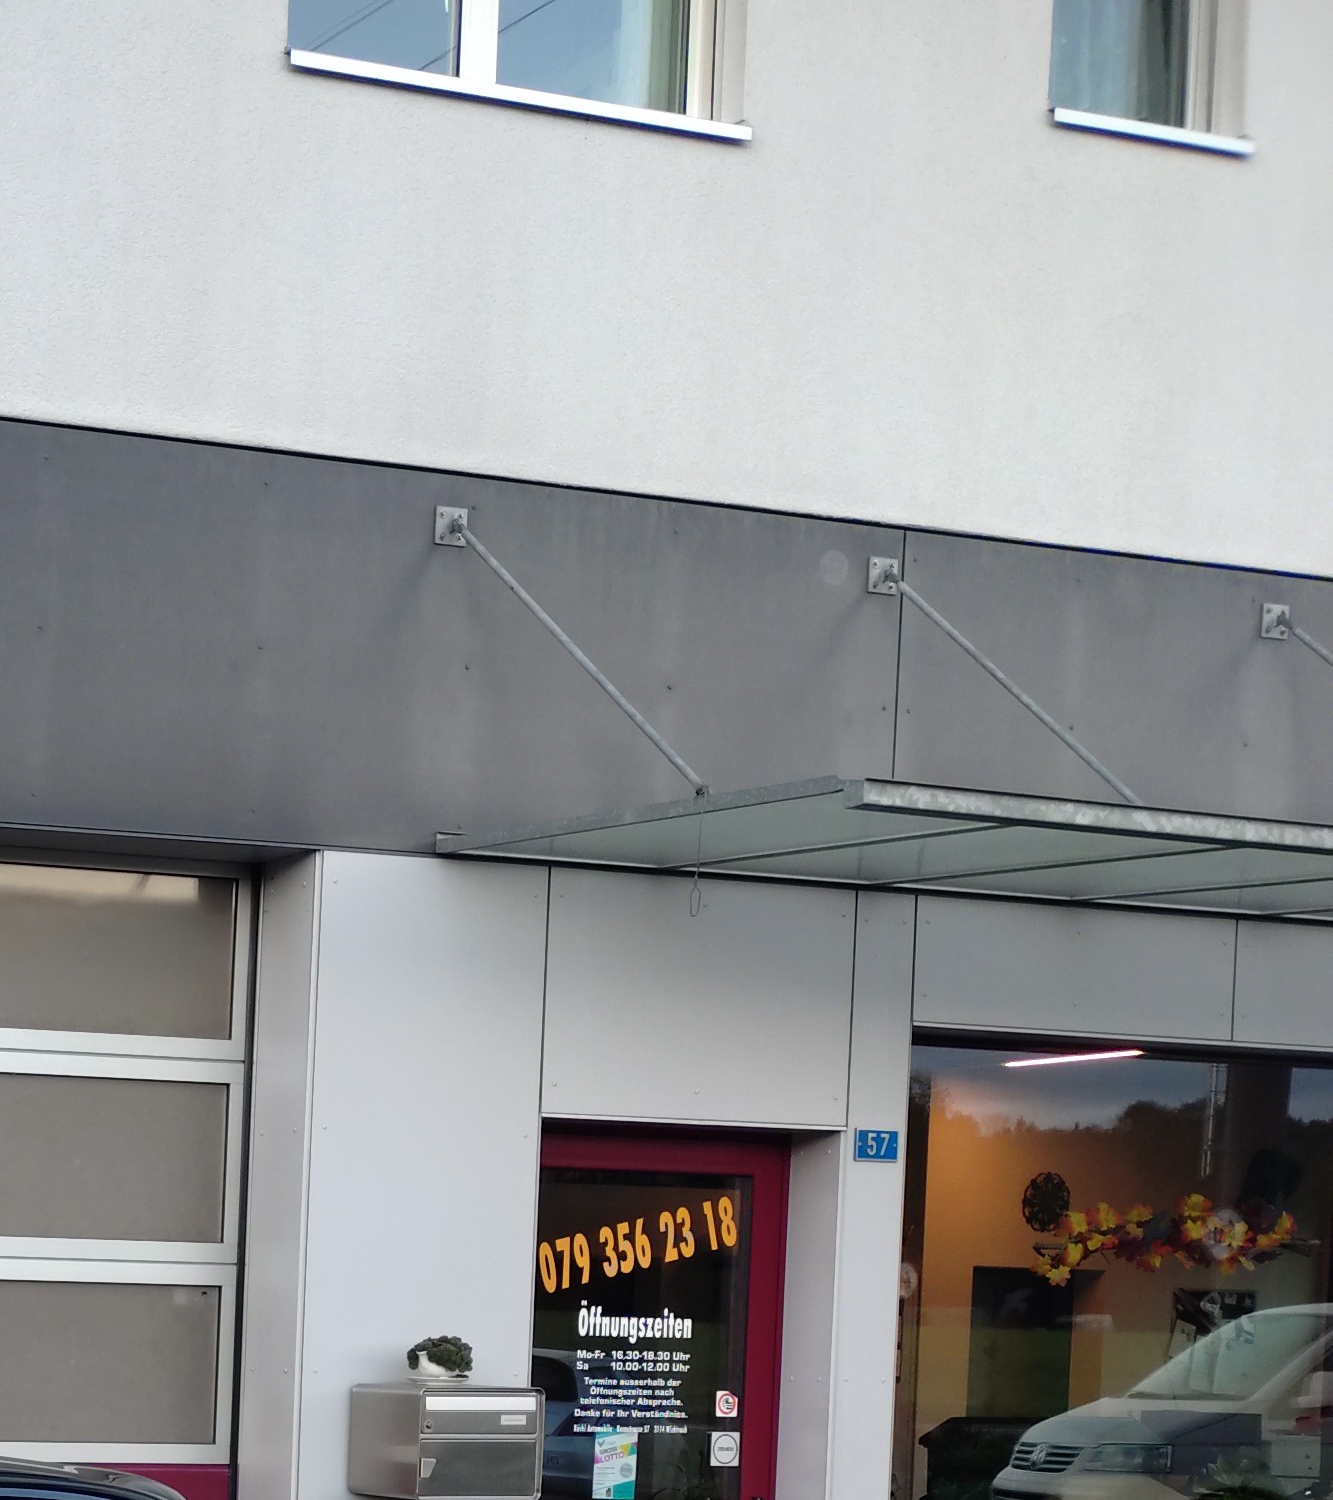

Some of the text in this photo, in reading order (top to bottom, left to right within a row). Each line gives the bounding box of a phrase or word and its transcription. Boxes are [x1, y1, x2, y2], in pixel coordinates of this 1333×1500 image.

[866, 1133, 890, 1156] 57
[539, 1196, 737, 1293] 079 356 23 18
[577, 1300, 692, 1344] Öffnungszeiten
[576, 1350, 606, 1359] Mo-Fr
[672, 1352, 691, 1361] Uhr
[576, 1361, 589, 1370] Sa
[672, 1362, 690, 1372] Uhr
[583, 1376, 618, 1385] Termine
[666, 1378, 682, 1387] der
[589, 1385, 674, 1397] Öffnungszeiten nach
[574, 1408, 601, 1417] Danke
[602, 1409, 615, 1417] für
[617, 1409, 630, 1417] Ihr
[600, 1451, 625, 1463] LOTTO
